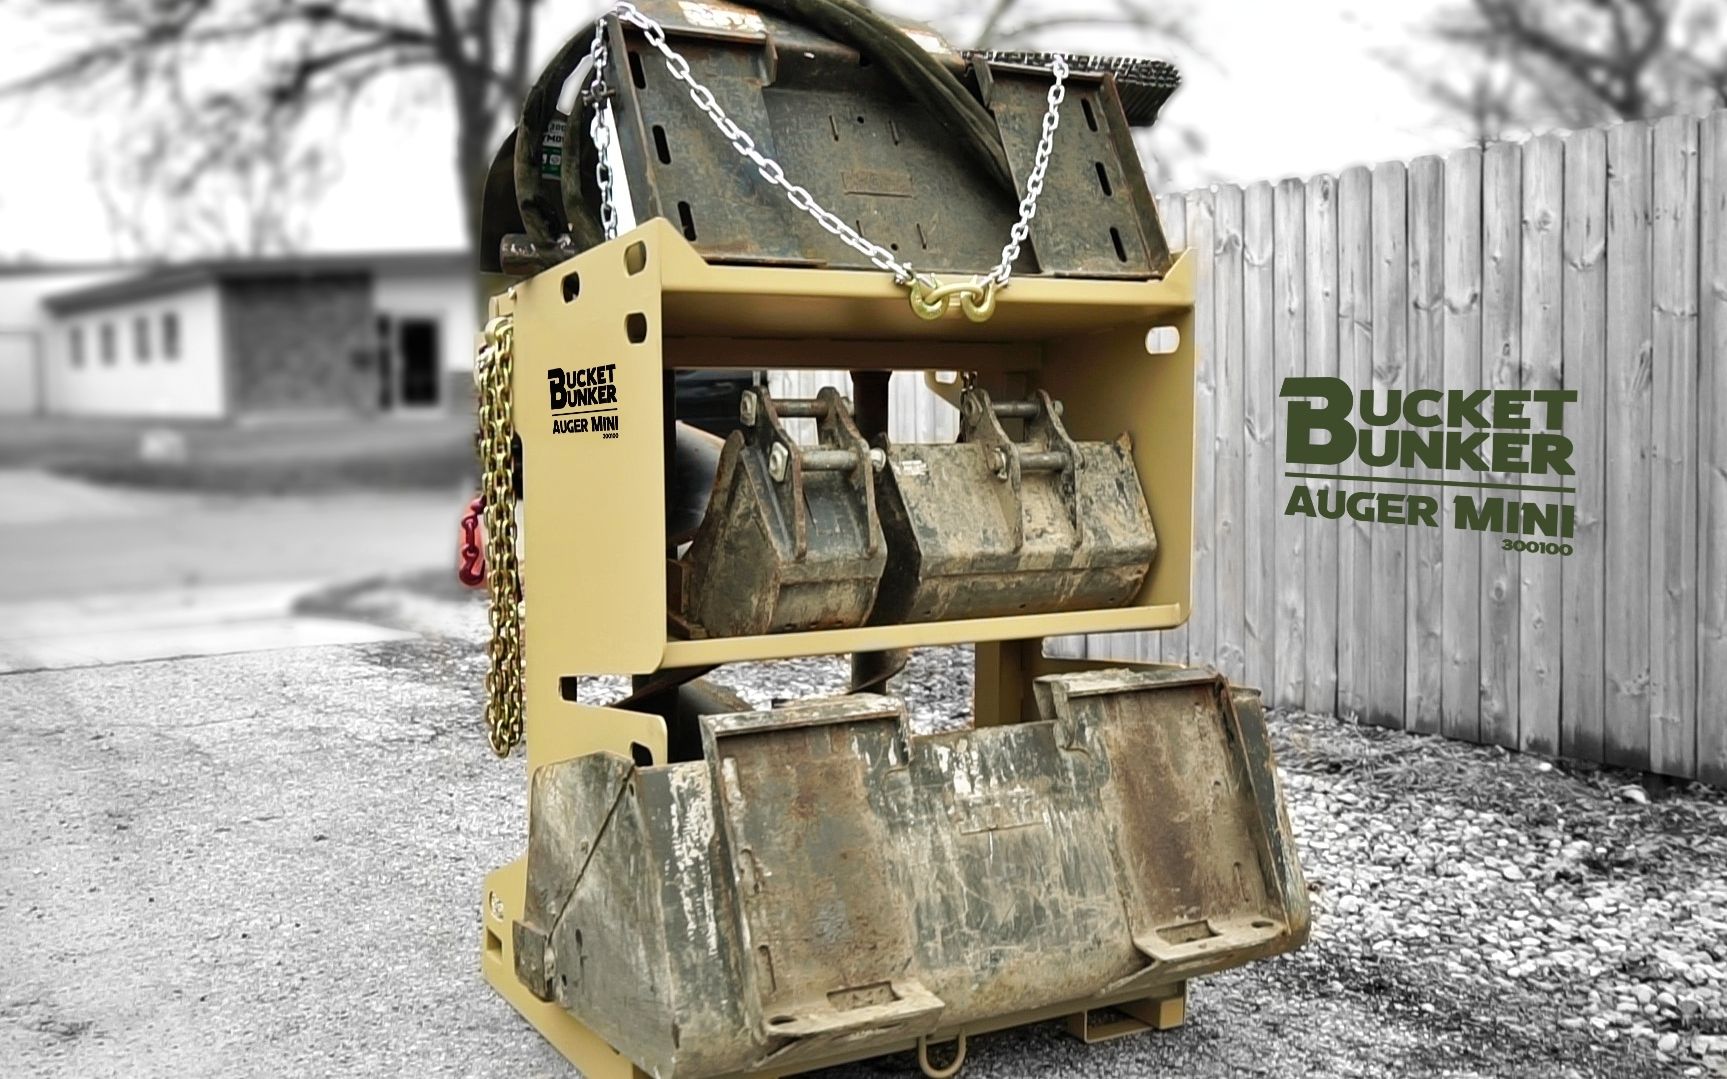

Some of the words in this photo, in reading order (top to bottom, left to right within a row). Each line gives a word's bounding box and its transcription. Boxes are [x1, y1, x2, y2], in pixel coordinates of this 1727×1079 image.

[547, 363, 616, 390] BUCKET
[549, 384, 618, 410] BUNKER
[552, 419, 589, 434] AUGER
[590, 415, 619, 432] MINI
